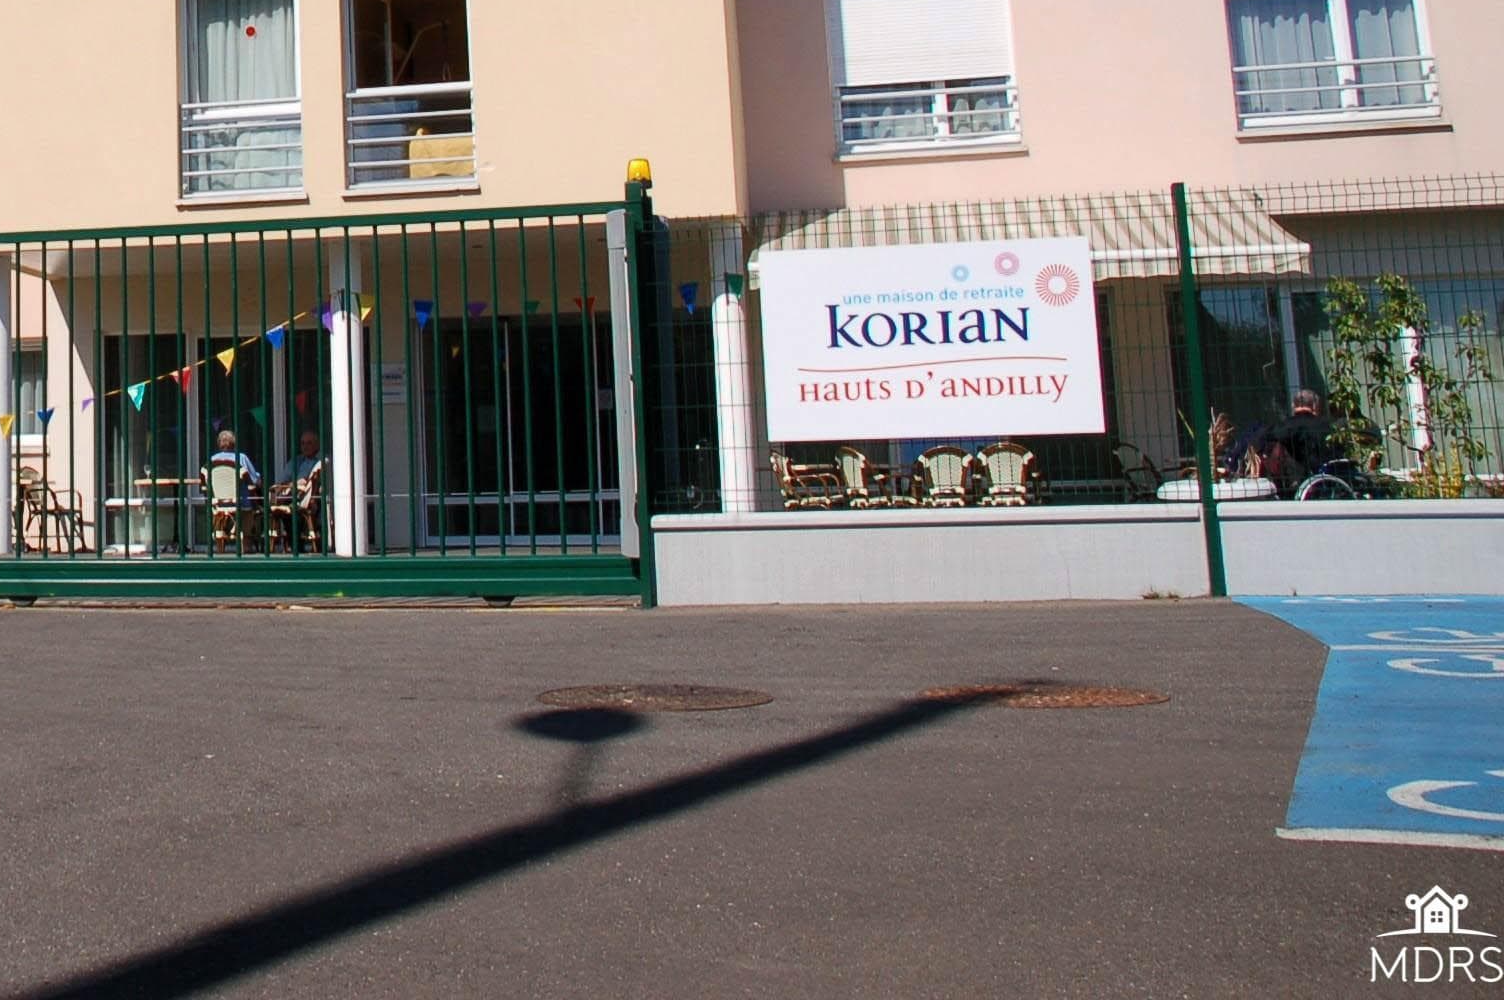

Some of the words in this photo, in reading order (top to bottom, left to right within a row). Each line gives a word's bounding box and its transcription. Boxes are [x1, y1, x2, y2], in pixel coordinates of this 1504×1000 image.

[843, 294, 872, 305] une
[877, 290, 934, 303] maison
[939, 288, 958, 301] de
[963, 285, 1024, 299] retraite
